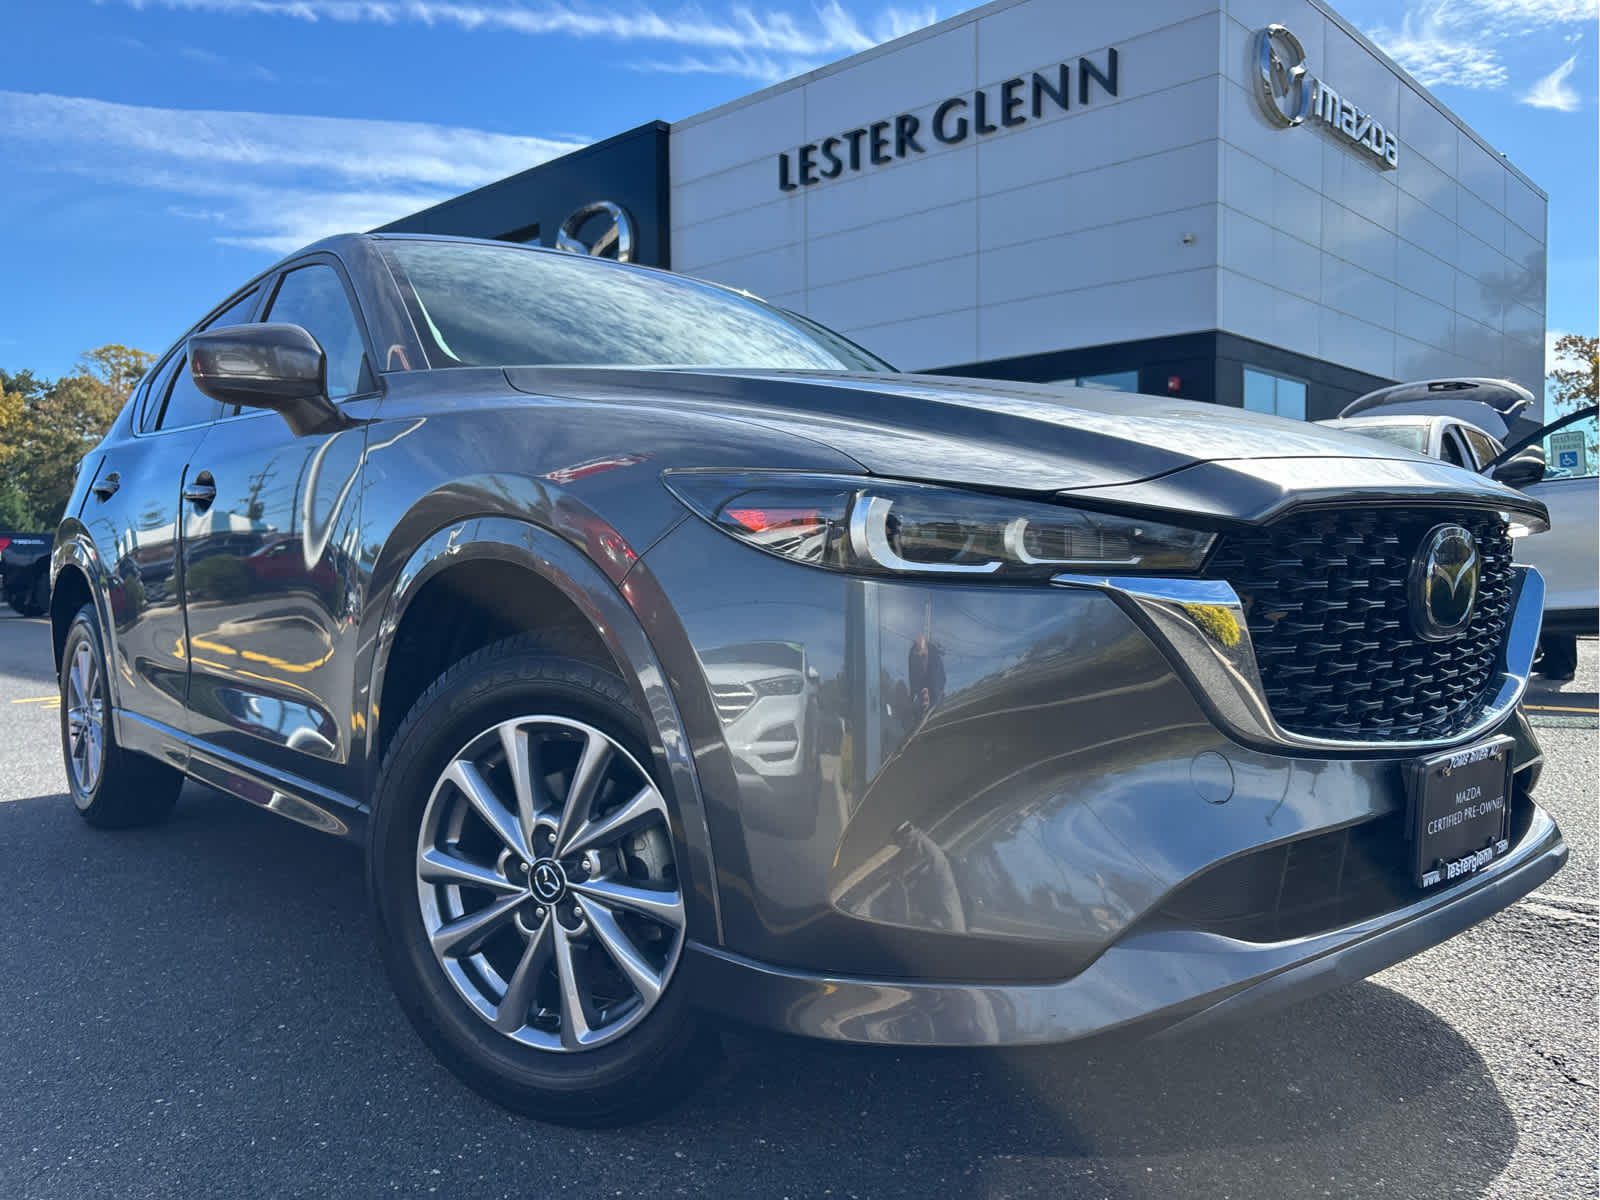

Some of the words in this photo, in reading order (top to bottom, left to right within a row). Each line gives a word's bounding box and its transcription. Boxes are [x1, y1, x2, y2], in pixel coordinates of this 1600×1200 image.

[779, 113, 926, 192] LESTER
[932, 47, 1119, 145] GLENN
[1428, 811, 1463, 835] CERTIFIED
[1464, 795, 1504, 820] PRE-OWNED
[1455, 786, 1481, 805] MAZDA
